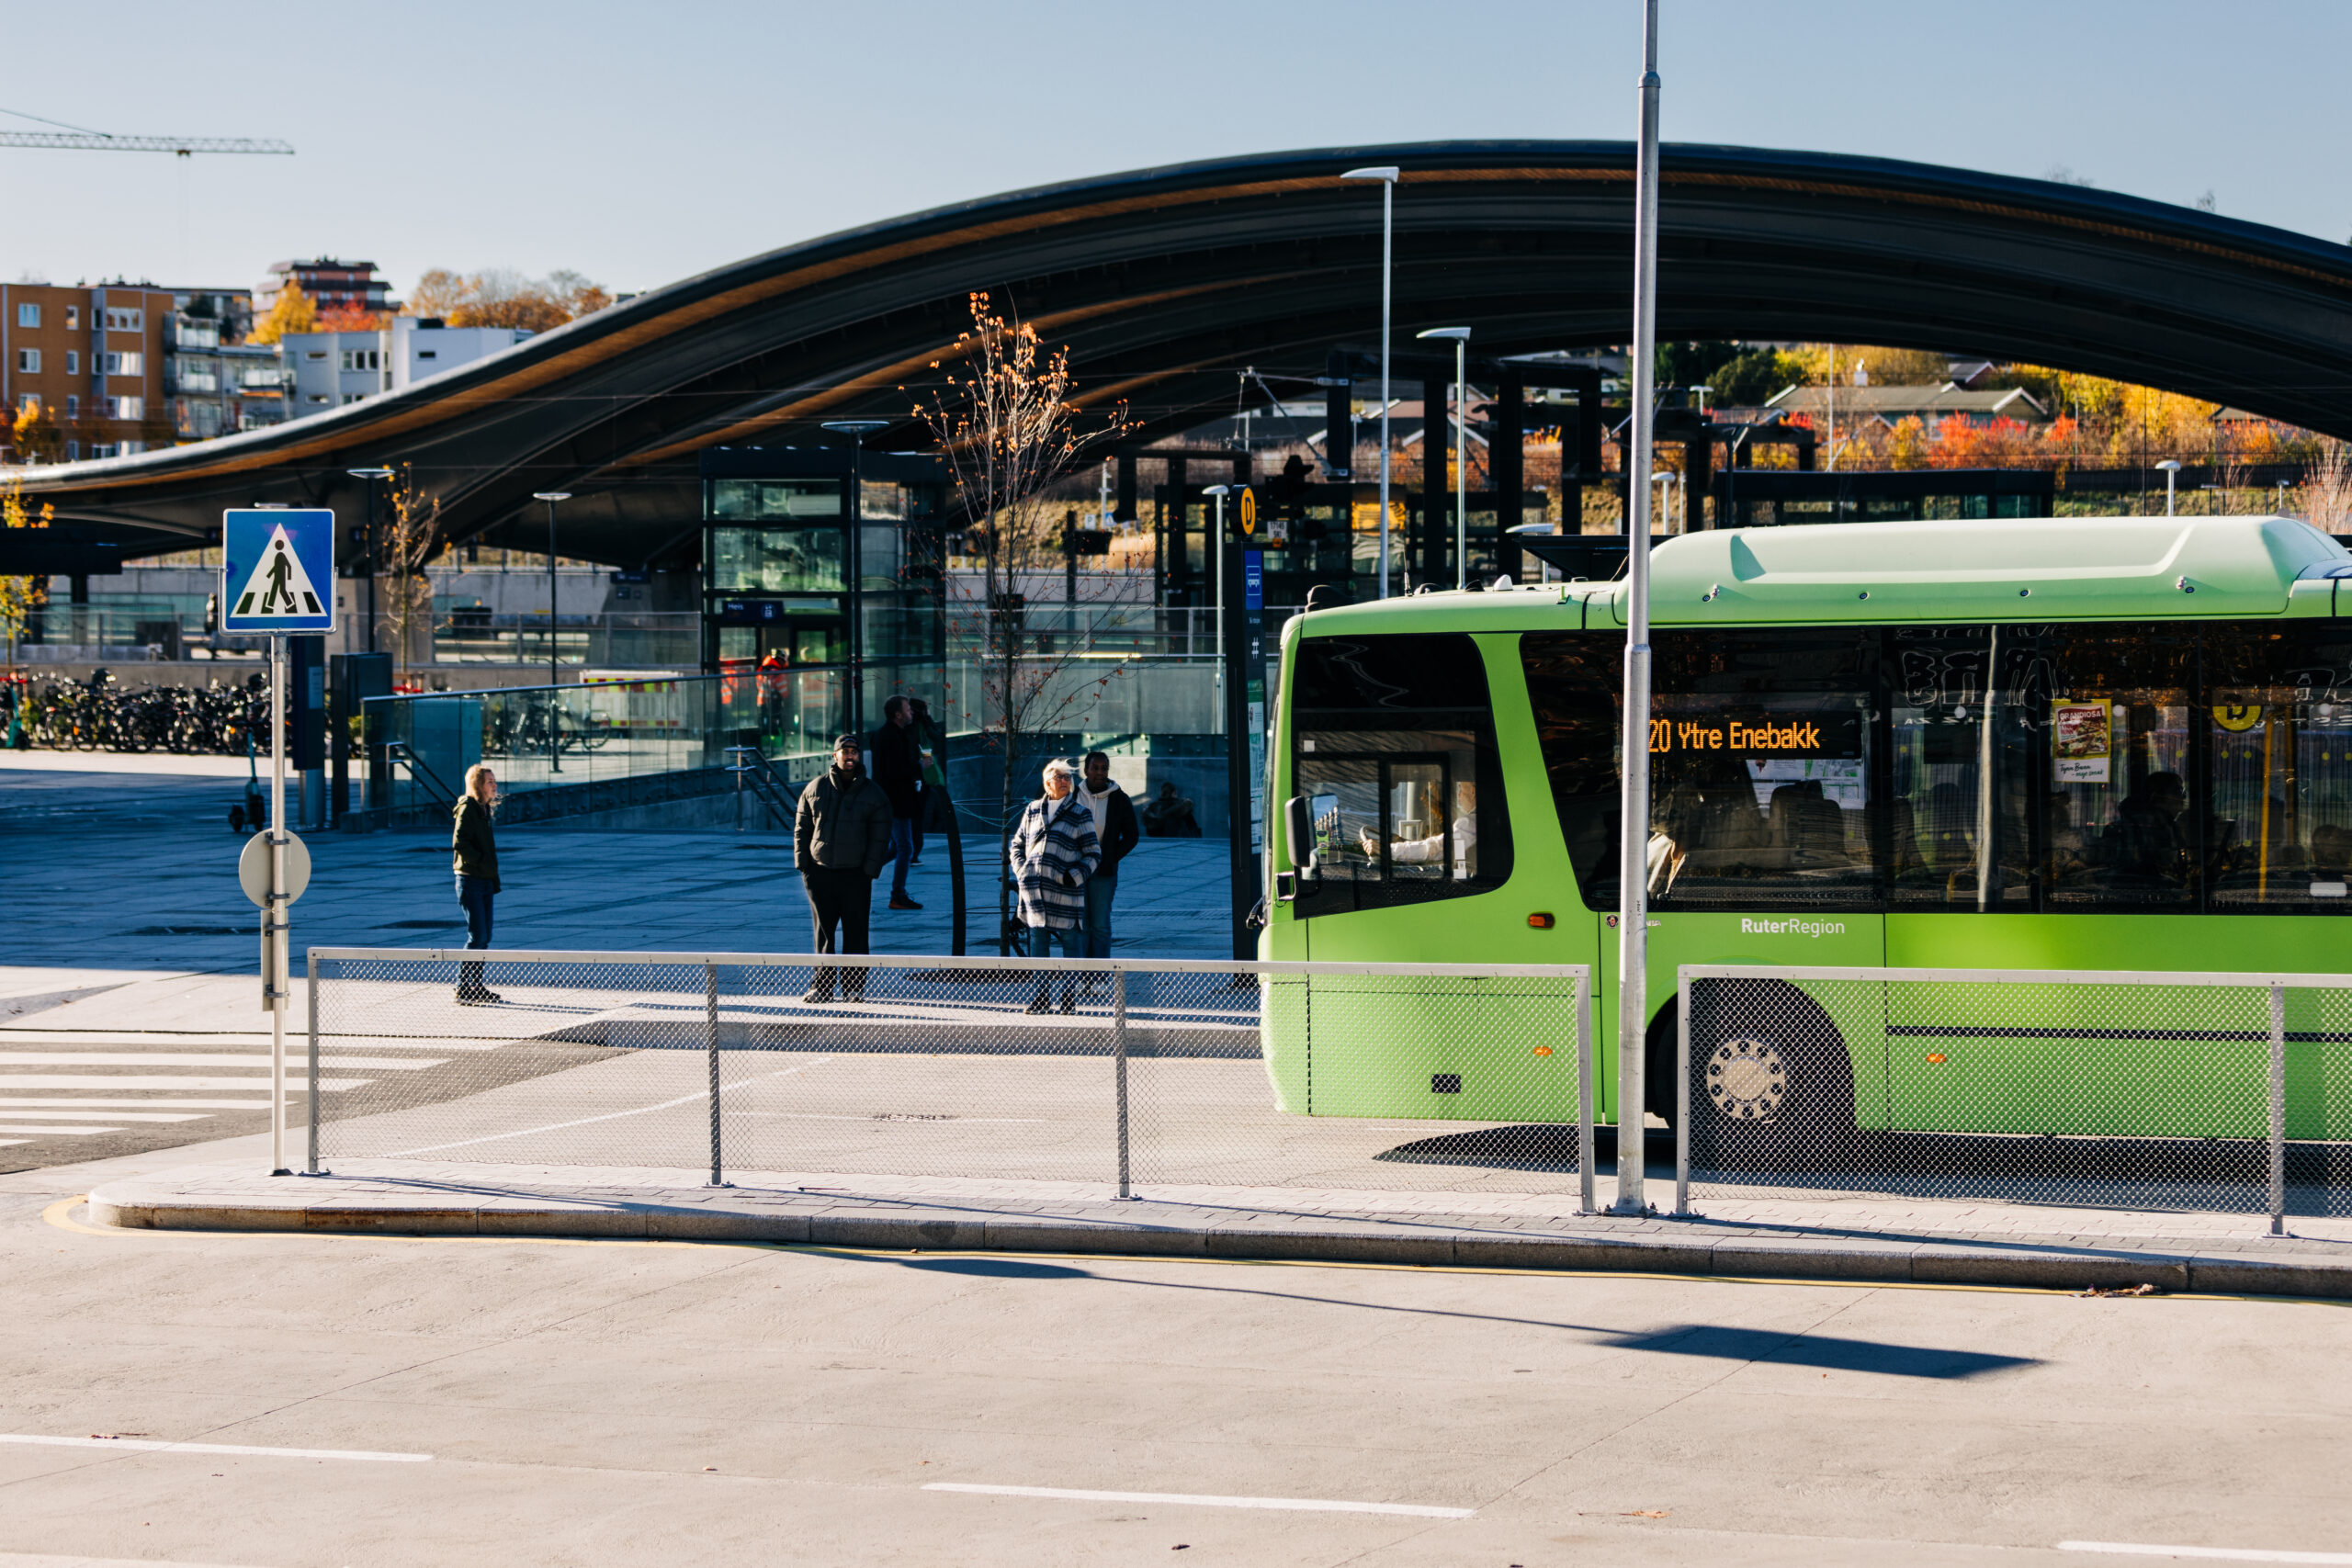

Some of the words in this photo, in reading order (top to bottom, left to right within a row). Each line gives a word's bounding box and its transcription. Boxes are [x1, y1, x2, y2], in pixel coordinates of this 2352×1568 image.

[1245, 497, 1252, 525] D
[728, 603, 744, 611] Heis
[2059, 710, 2101, 720] GRANDIOSA
[1679, 723, 1723, 749] Ytre
[1730, 722, 1820, 749] Enebakk
[1742, 919, 1845, 938] RuterRegion
